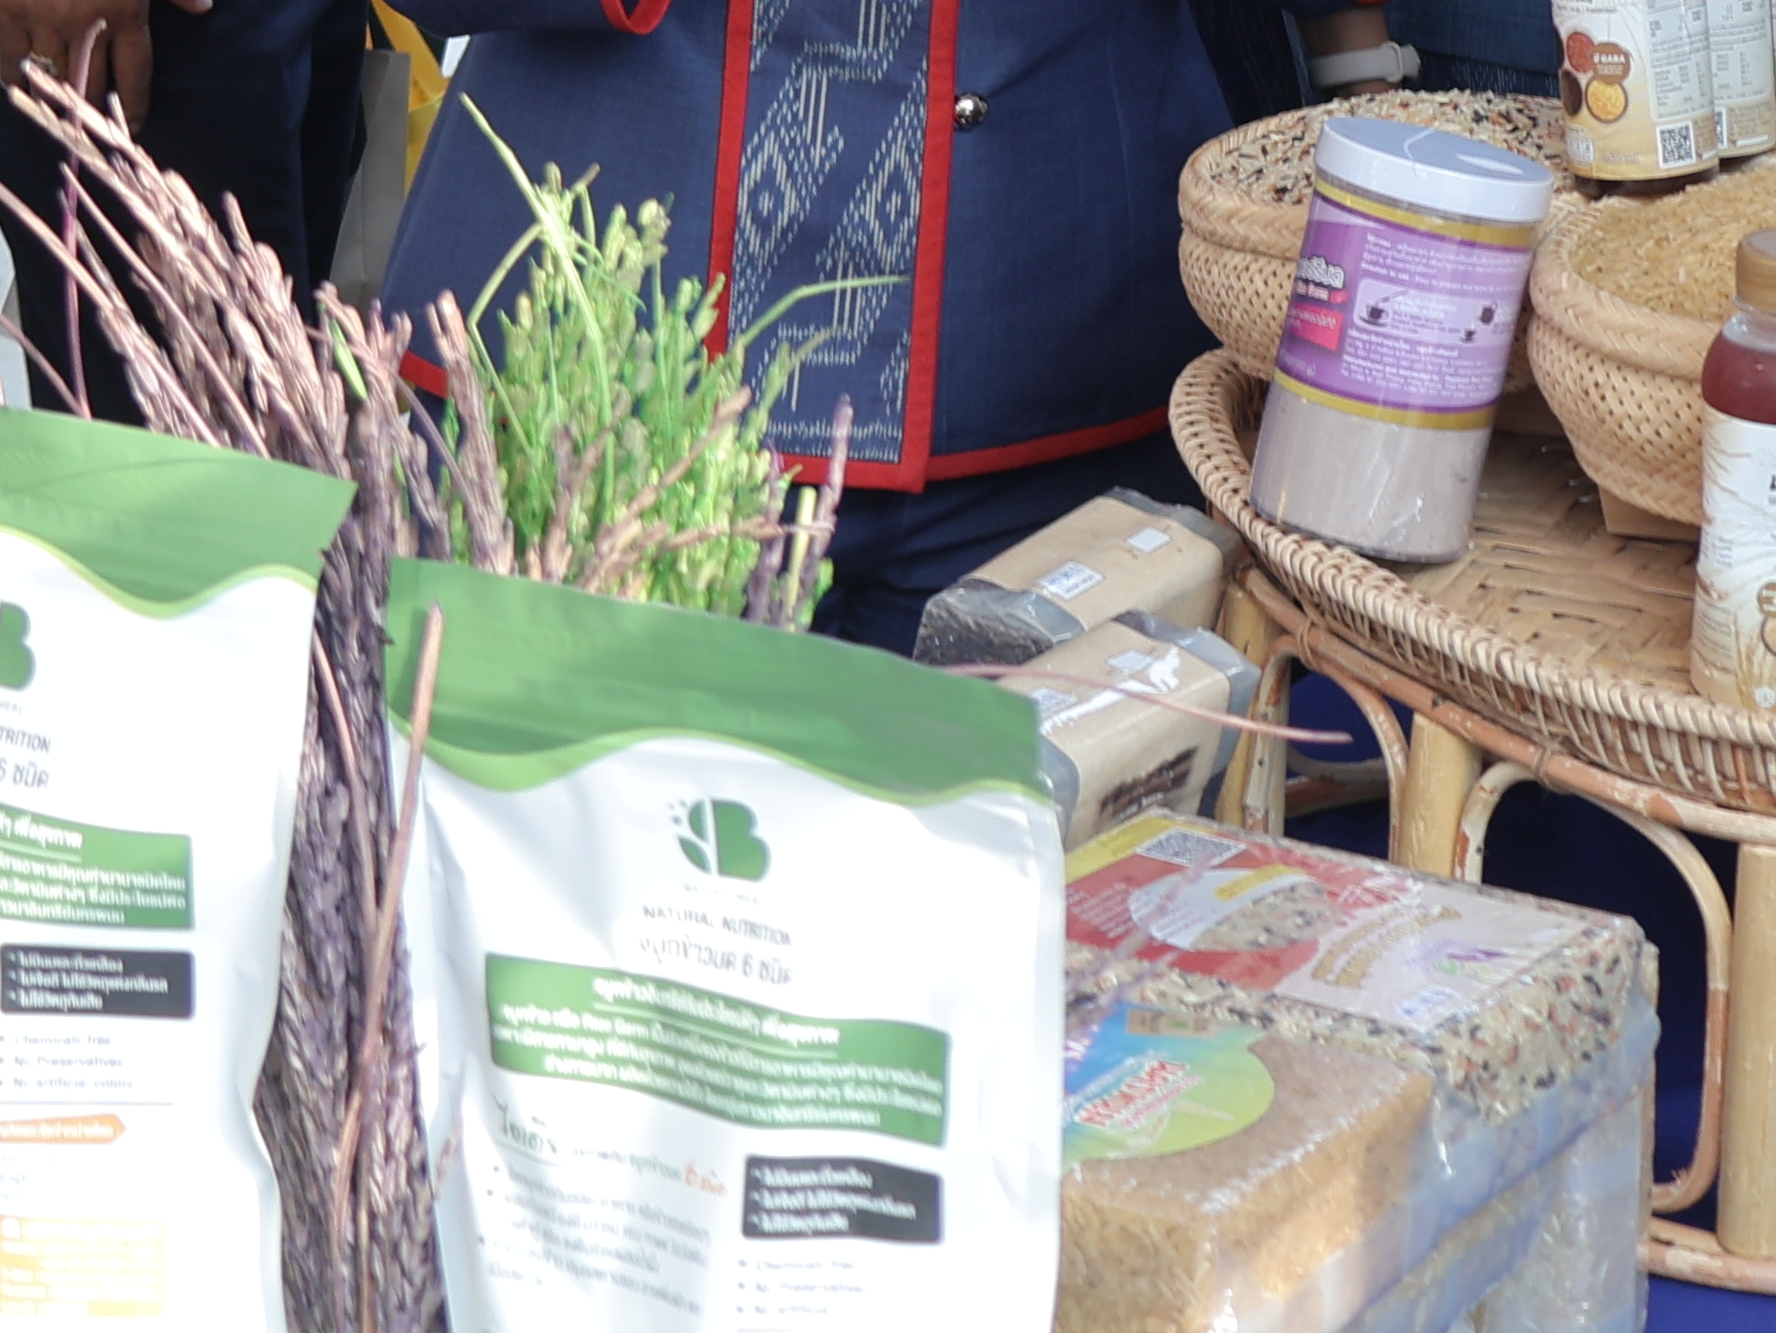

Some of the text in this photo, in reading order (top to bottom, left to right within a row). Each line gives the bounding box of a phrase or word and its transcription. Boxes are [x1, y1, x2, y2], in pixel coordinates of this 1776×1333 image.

[12, 759, 50, 790] ชนิด
[720, 915, 793, 948] NUTRITION
[740, 951, 754, 979] 6
